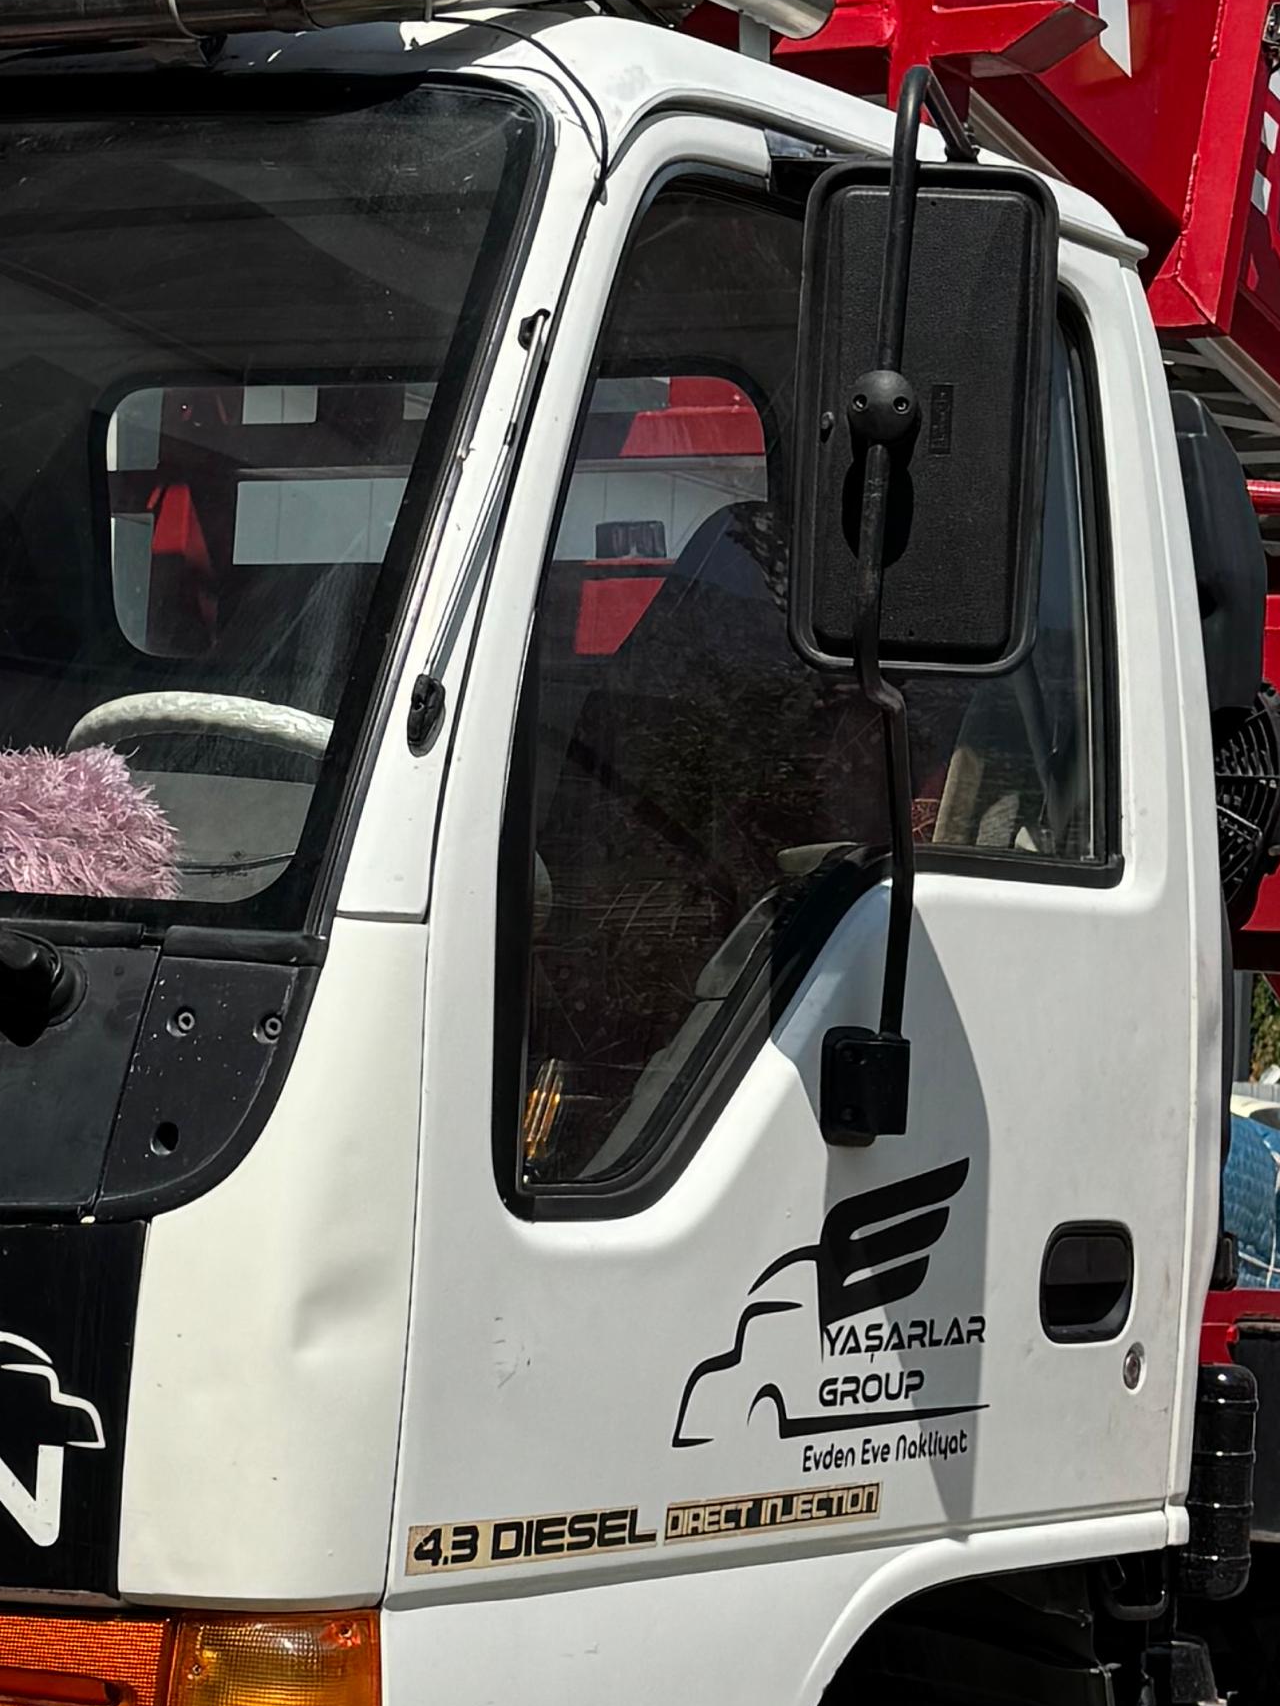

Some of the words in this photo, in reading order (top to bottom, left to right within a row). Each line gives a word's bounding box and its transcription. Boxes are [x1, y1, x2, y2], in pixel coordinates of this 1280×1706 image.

[823, 1315, 987, 1364] YAŞARLAR
[819, 1369, 925, 1407] GROUP
[802, 1443, 856, 1473] Evden
[861, 1438, 891, 1465] Eve
[666, 1499, 754, 1540] DIRECT
[759, 1483, 879, 1525] INJECTION
[413, 1525, 481, 1567] 4.3
[490, 1508, 657, 1561] DIESEL
